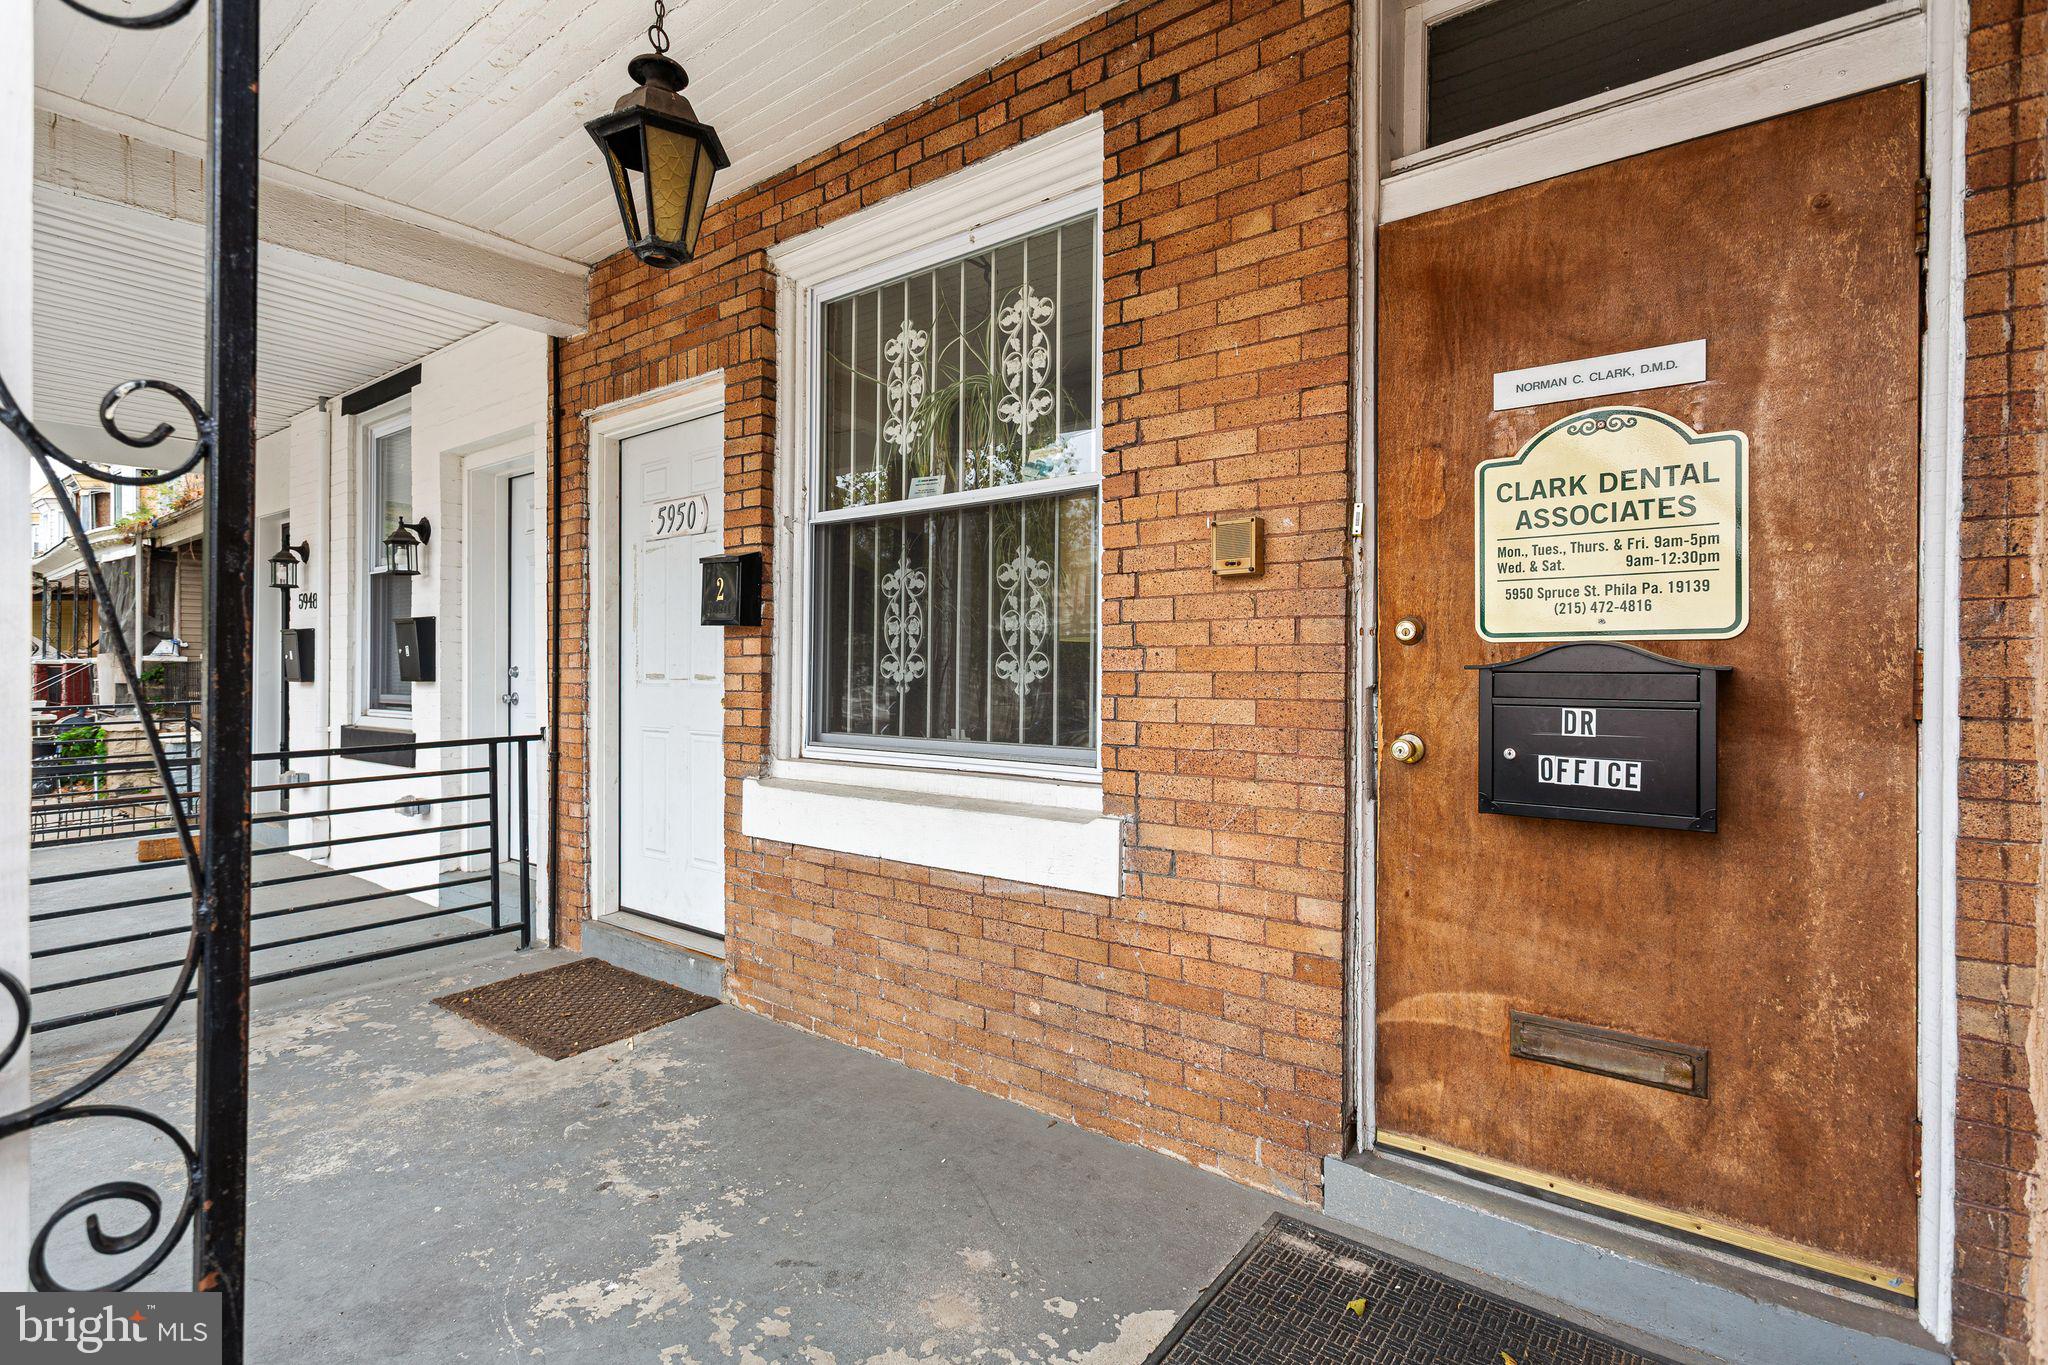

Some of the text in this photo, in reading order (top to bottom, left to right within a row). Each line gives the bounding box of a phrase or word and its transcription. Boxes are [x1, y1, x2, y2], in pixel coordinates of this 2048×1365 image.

[1516, 360, 1678, 393] NORMAN C. CLARK, D.M.D.
[1496, 461, 1720, 503] CLARK DENTAL
[656, 500, 697, 535] 5950
[1515, 494, 1697, 531] ASSOCIATES
[1497, 533, 1720, 559] Mon., Tues., Thurs. & Fri. 9am-5pm
[1497, 550, 1720, 574] Wed. & Sat. 9am-12:30pm
[298, 592, 318, 610] 5948
[716, 577, 724, 602] 2
[1505, 579, 1710, 601] 5950 Spruce St. Phila Pa. 19139
[1554, 599, 1652, 616] (215) 472-4816
[1564, 710, 1594, 735] DR
[1540, 757, 1639, 789] OFFICE
